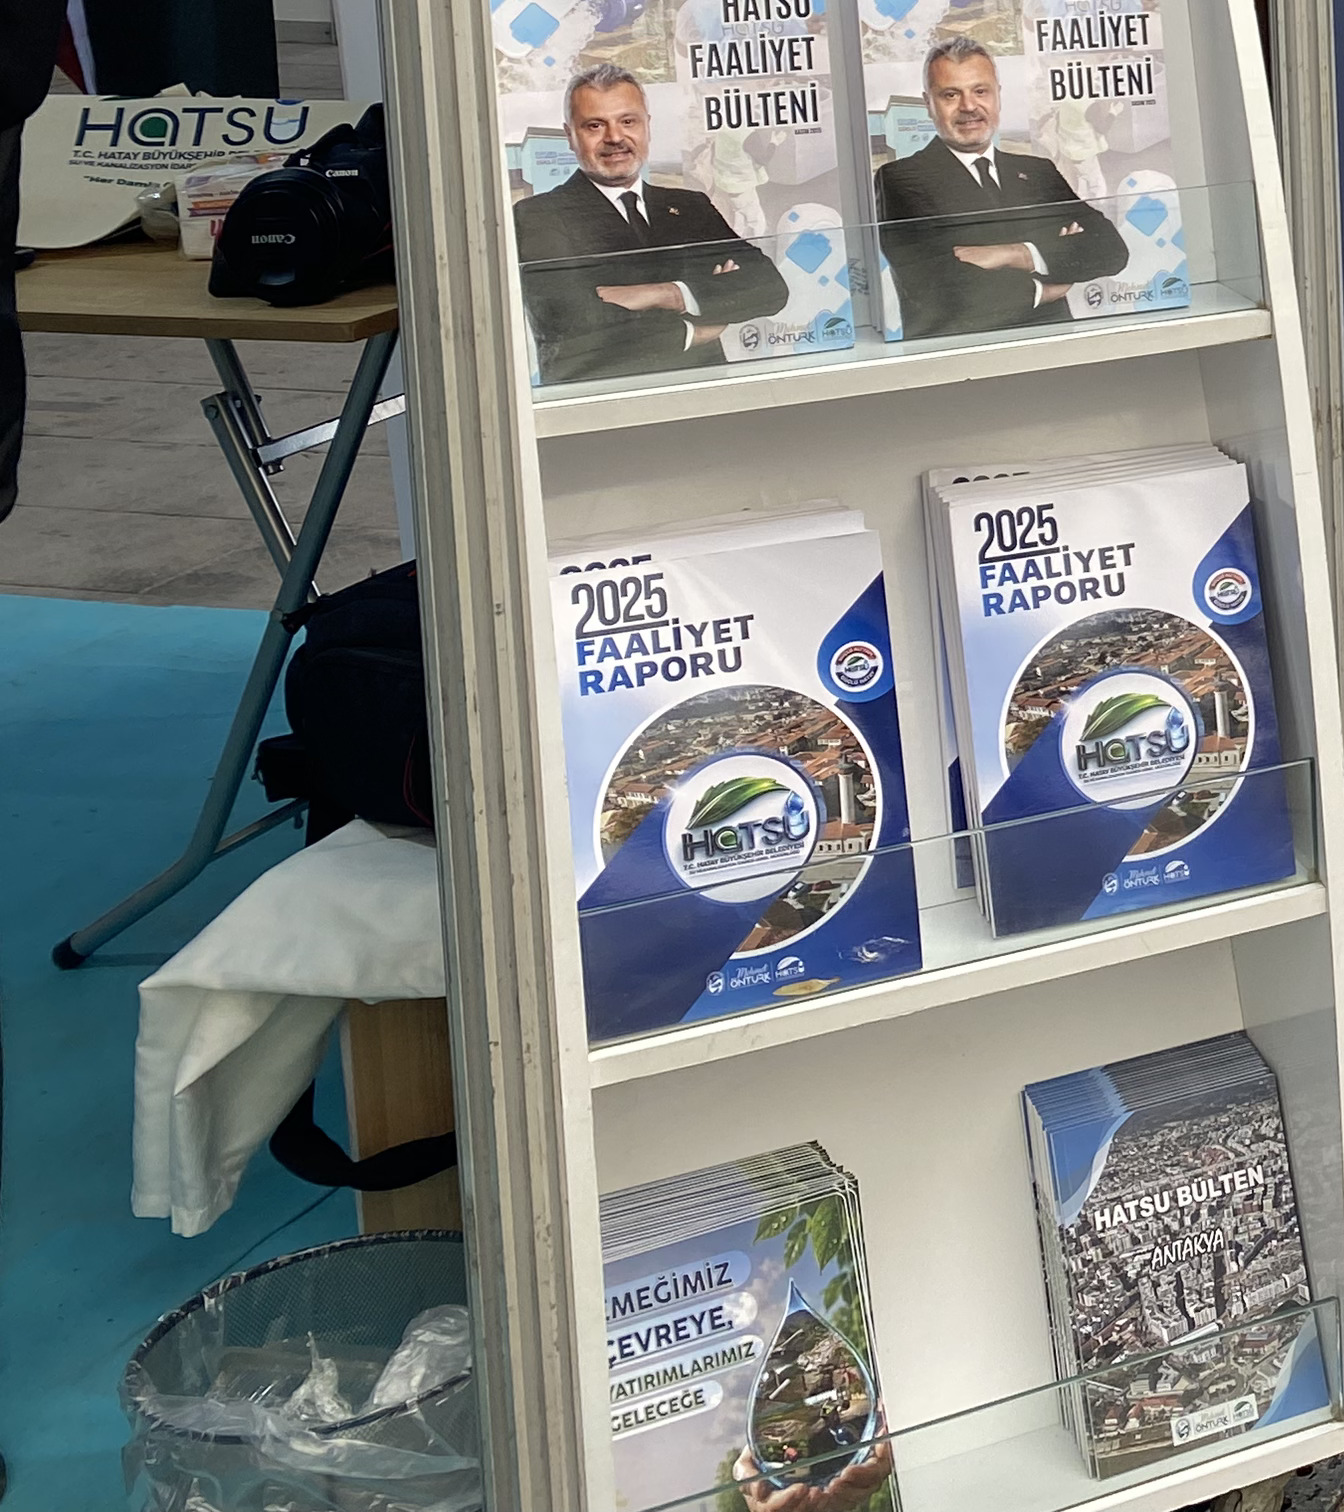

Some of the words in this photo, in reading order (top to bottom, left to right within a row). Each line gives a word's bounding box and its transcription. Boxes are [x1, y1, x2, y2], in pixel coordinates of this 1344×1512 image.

[1036, 10, 1150, 52] FAALİYET
[689, 33, 815, 79] FAALİYET
[1050, 57, 1153, 101] BÜLTENİ
[704, 82, 819, 131] BÜLTENİ
[98, 151, 140, 160] HATAY
[325, 169, 359, 178] Canon
[251, 233, 296, 244] Canon
[973, 503, 1059, 564] 2025
[979, 543, 1135, 589] FAALİYET
[571, 572, 669, 640] 2025
[982, 572, 1126, 617] RAPORU
[576, 614, 754, 666] FAALİYET
[579, 646, 743, 696] RAPORU
[1093, 1191, 1170, 1230] HATSU
[1178, 1164, 1265, 1208] BÜLTEN
[1150, 1228, 1225, 1270] ANTAKYA
[606, 1260, 732, 1320] MEĞİMİZ
